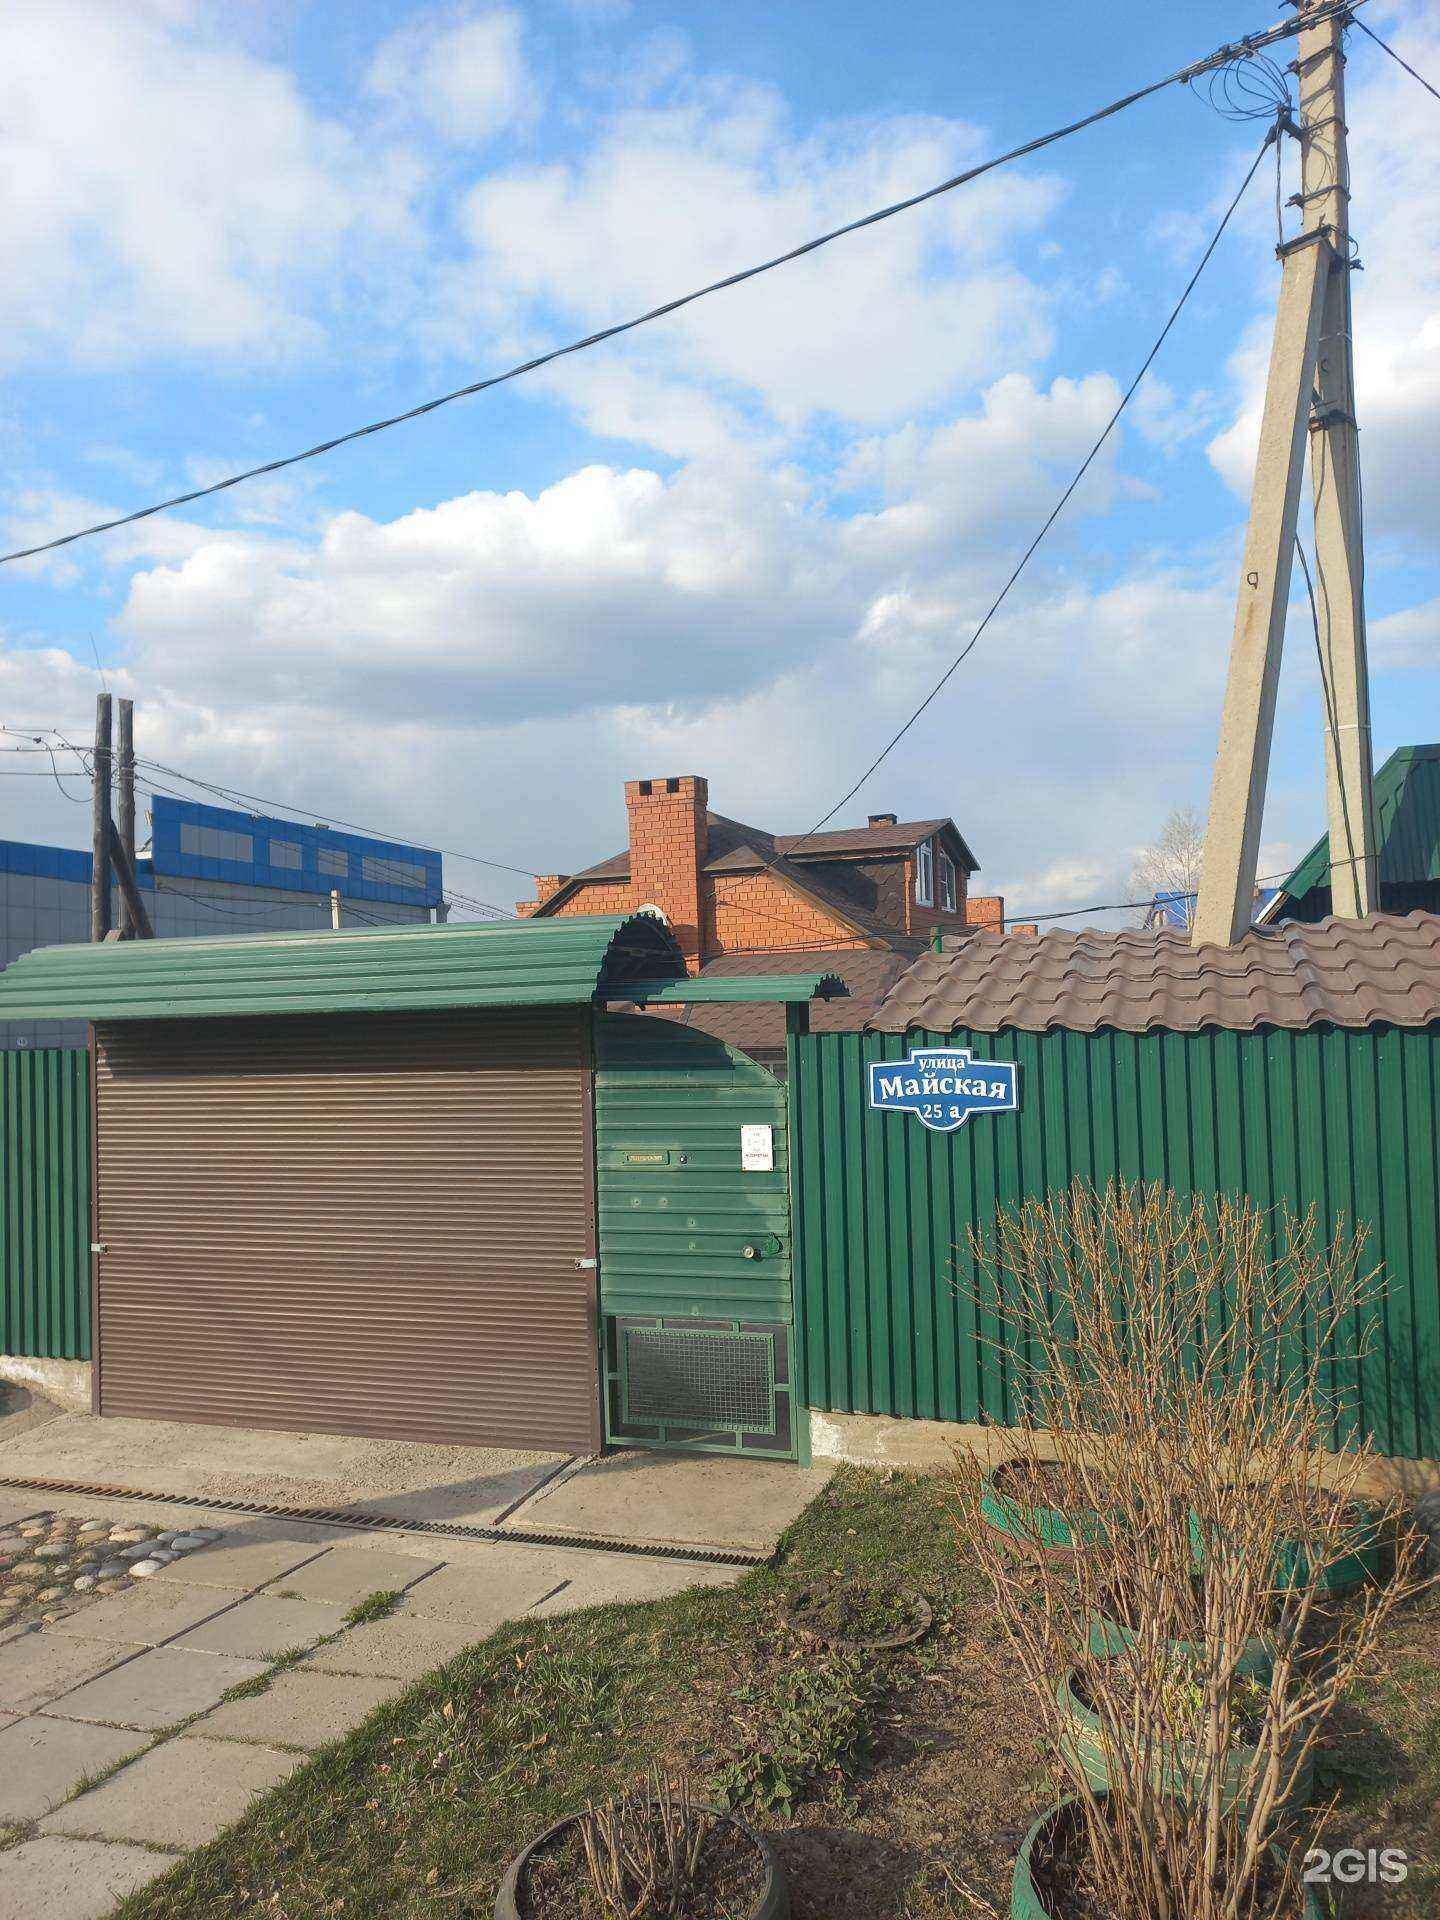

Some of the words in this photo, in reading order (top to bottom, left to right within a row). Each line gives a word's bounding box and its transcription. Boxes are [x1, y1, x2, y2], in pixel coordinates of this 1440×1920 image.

[918, 1057, 966, 1073] улица
[878, 1072, 1008, 1101] Майская
[923, 1103, 943, 1119] 25
[949, 1104, 962, 1119] а
